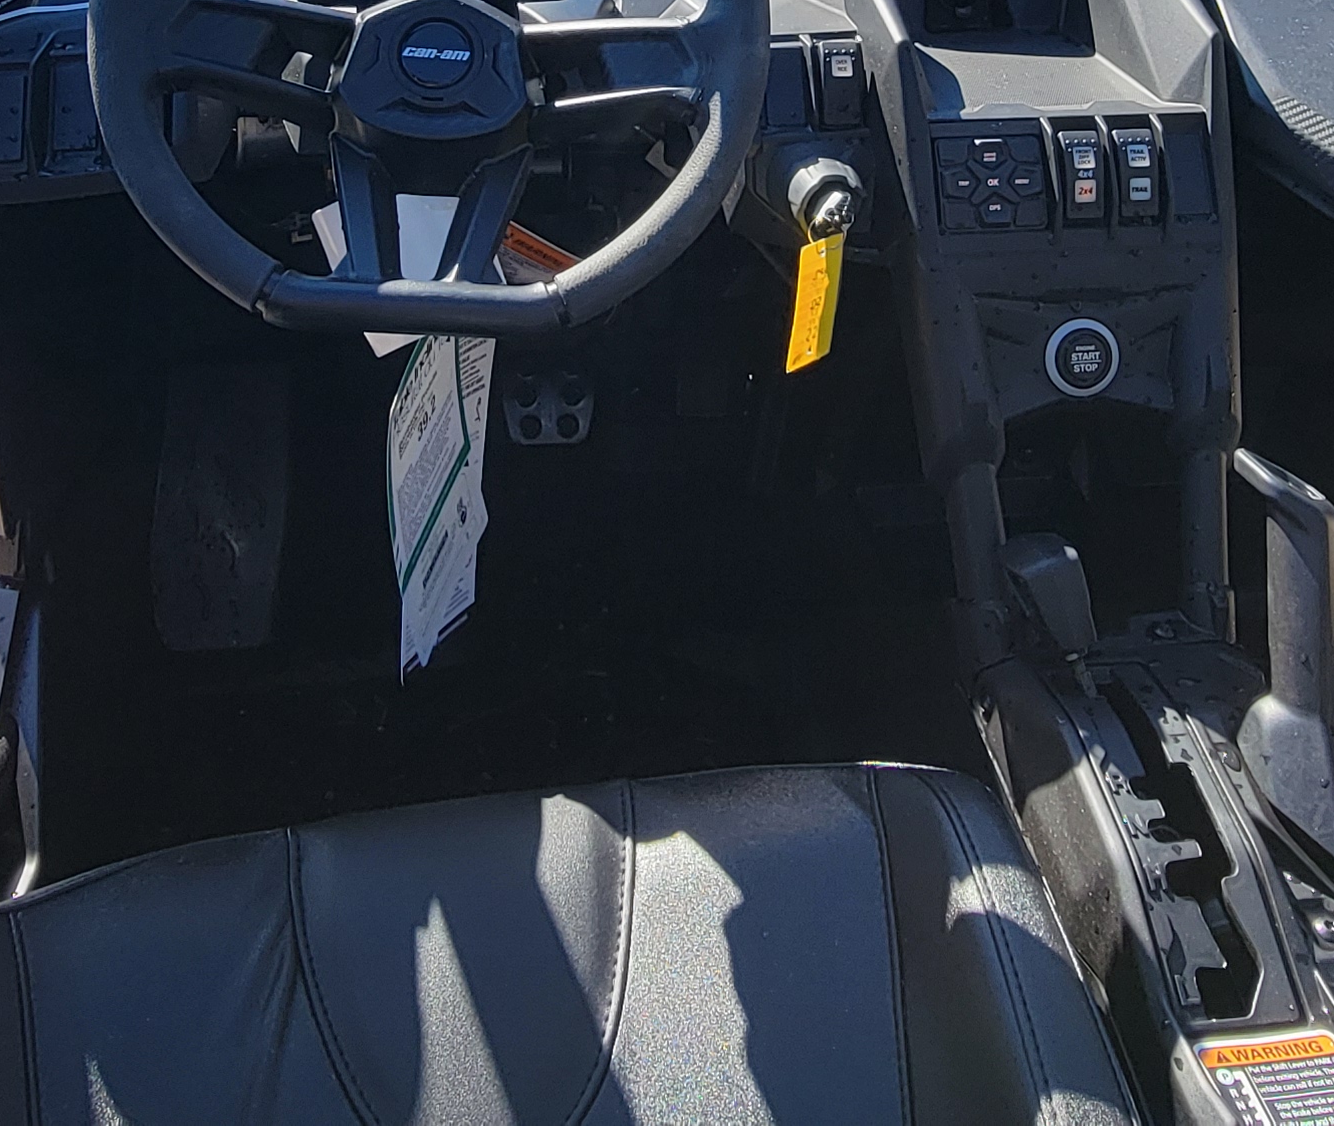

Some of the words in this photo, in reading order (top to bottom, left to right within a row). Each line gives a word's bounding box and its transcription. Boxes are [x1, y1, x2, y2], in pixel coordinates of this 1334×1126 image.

[402, 47, 471, 61] can-am
[1078, 170, 1094, 178] 4x4
[987, 178, 999, 186] OK
[1078, 187, 1093, 195] 2x4
[1071, 352, 1100, 361] START
[1074, 364, 1098, 373] STOP
[418, 394, 436, 442] 39.2
[1231, 1040, 1323, 1062] WARNING
[1261, 1063, 1271, 1072] the
[1272, 1061, 1288, 1072] Shift
[1289, 1060, 1307, 1069] Lever
[1308, 1059, 1315, 1067] to
[1253, 1074, 1275, 1084] before
[1259, 1084, 1282, 1094] vehicle
[1284, 1083, 1296, 1091] can
[1297, 1082, 1307, 1090] roll
[1229, 1088, 1239, 1099] R
[1236, 1098, 1246, 1110] N
[1274, 1102, 1290, 1112] Stop
[1292, 1100, 1303, 1108] the
[1305, 1097, 1327, 1108] vehicle
[1312, 1107, 1333, 1116] before
[1243, 1115, 1253, 1125] H
